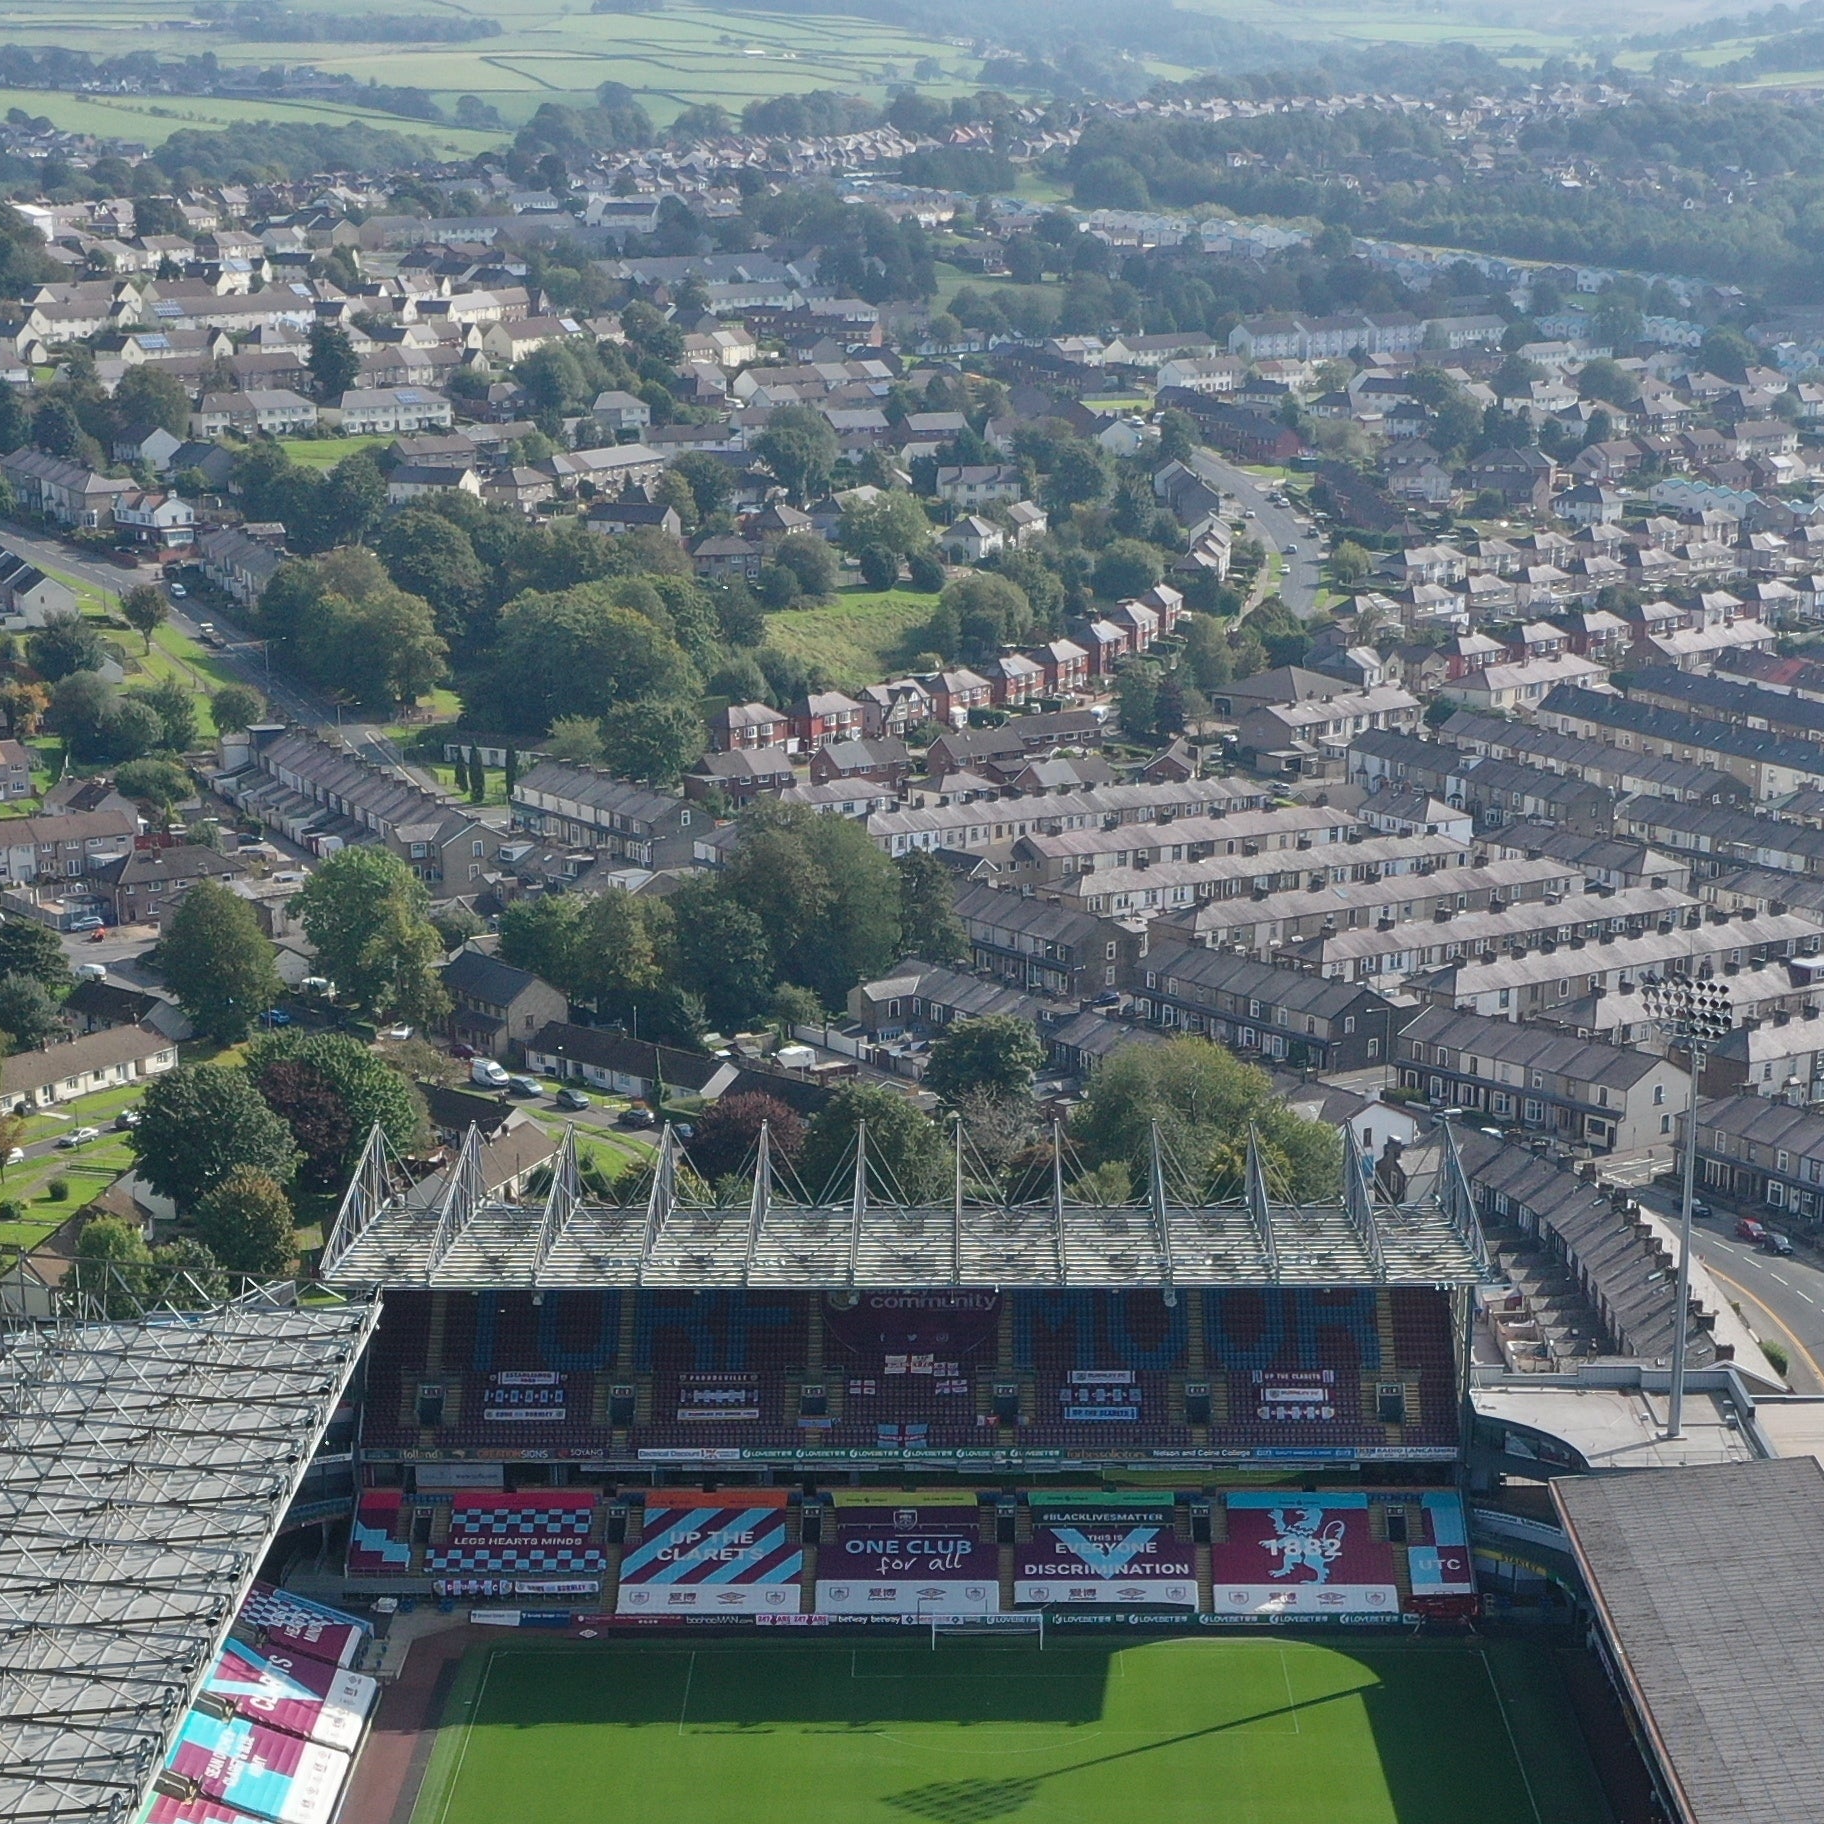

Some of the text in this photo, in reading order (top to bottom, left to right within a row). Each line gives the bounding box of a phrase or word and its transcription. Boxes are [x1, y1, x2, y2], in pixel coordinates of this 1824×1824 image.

[870, 1294, 997, 1311] community
[1152, 1449, 1180, 1457] Nelson
[1182, 1449, 1196, 1457] and
[1221, 1449, 1251, 1459] College
[1042, 1513, 1163, 1522] #BLACKLIVESMATTER
[454, 1537, 583, 1545] LEGS HEARTS MINDS
[670, 1531, 754, 1544] UP THE
[1087, 1534, 1123, 1542] THIS IS
[845, 1540, 973, 1555] ONE CLUB
[1055, 1541, 1157, 1554] EVERYONE
[1269, 1538, 1343, 1557] 1882
[656, 1547, 766, 1562] CLARETS
[876, 1553, 963, 1576] for all
[1024, 1563, 1190, 1576] DISCRIMINATION
[1419, 1558, 1462, 1571] UTC
[838, 1615, 901, 1625] betway betway
[249, 1654, 293, 1712] CLARETS
[204, 1757, 225, 1779] SEAN
